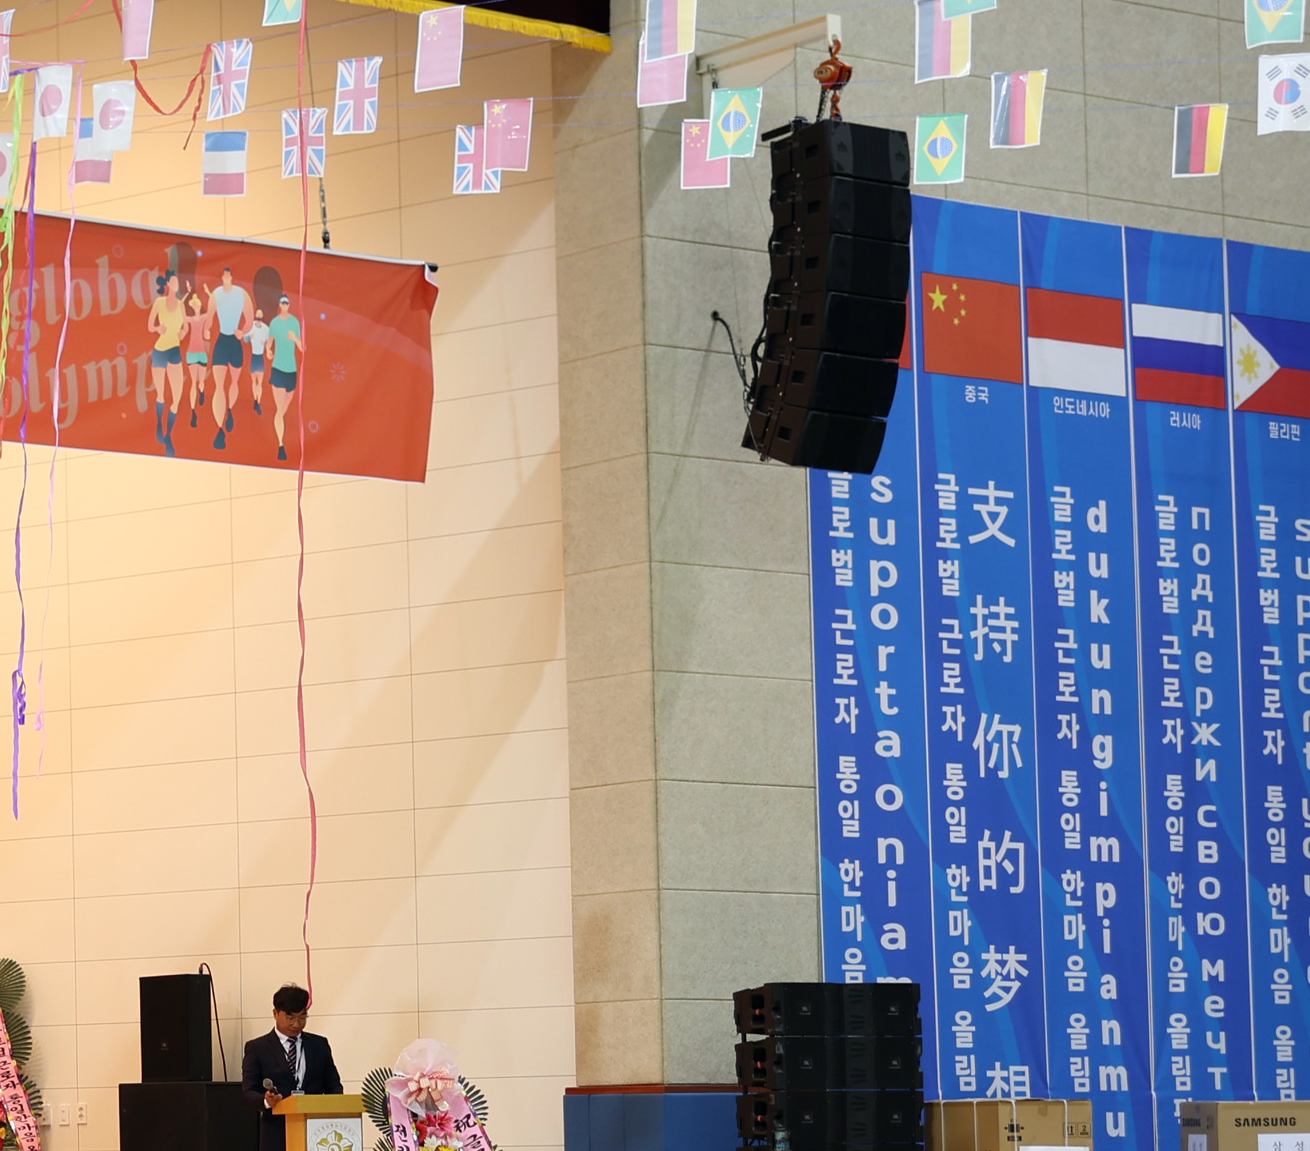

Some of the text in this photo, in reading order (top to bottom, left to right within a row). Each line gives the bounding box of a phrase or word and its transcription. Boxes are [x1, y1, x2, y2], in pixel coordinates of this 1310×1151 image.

[964, 385, 990, 405] 중국
[1052, 395, 1111, 420] 인도네시아
[1169, 410, 1202, 431] 러시아
[1268, 421, 1301, 442] 필리핀
[827, 471, 854, 587] 글로벌
[935, 473, 961, 597] 글로벌
[1050, 485, 1075, 607] 글로벌
[1256, 504, 1279, 625] 글로벌
[832, 608, 859, 734] 근로자
[938, 618, 966, 741] 근로자
[1054, 627, 1081, 750] 근로자
[1260, 645, 1284, 765] 근로자
[835, 755, 861, 838] 통일
[942, 761, 967, 844] 통일
[1154, 494, 1188, 993] 글로벌 근로자 통일 한마음
[1058, 769, 1082, 850] 통일
[1264, 785, 1287, 864] 통일
[946, 863, 974, 989] 한마음
[1061, 868, 1089, 991] 한마음
[1268, 883, 1292, 1005] 한마음
[1235, 1117, 1297, 1127] SAMSUNG
